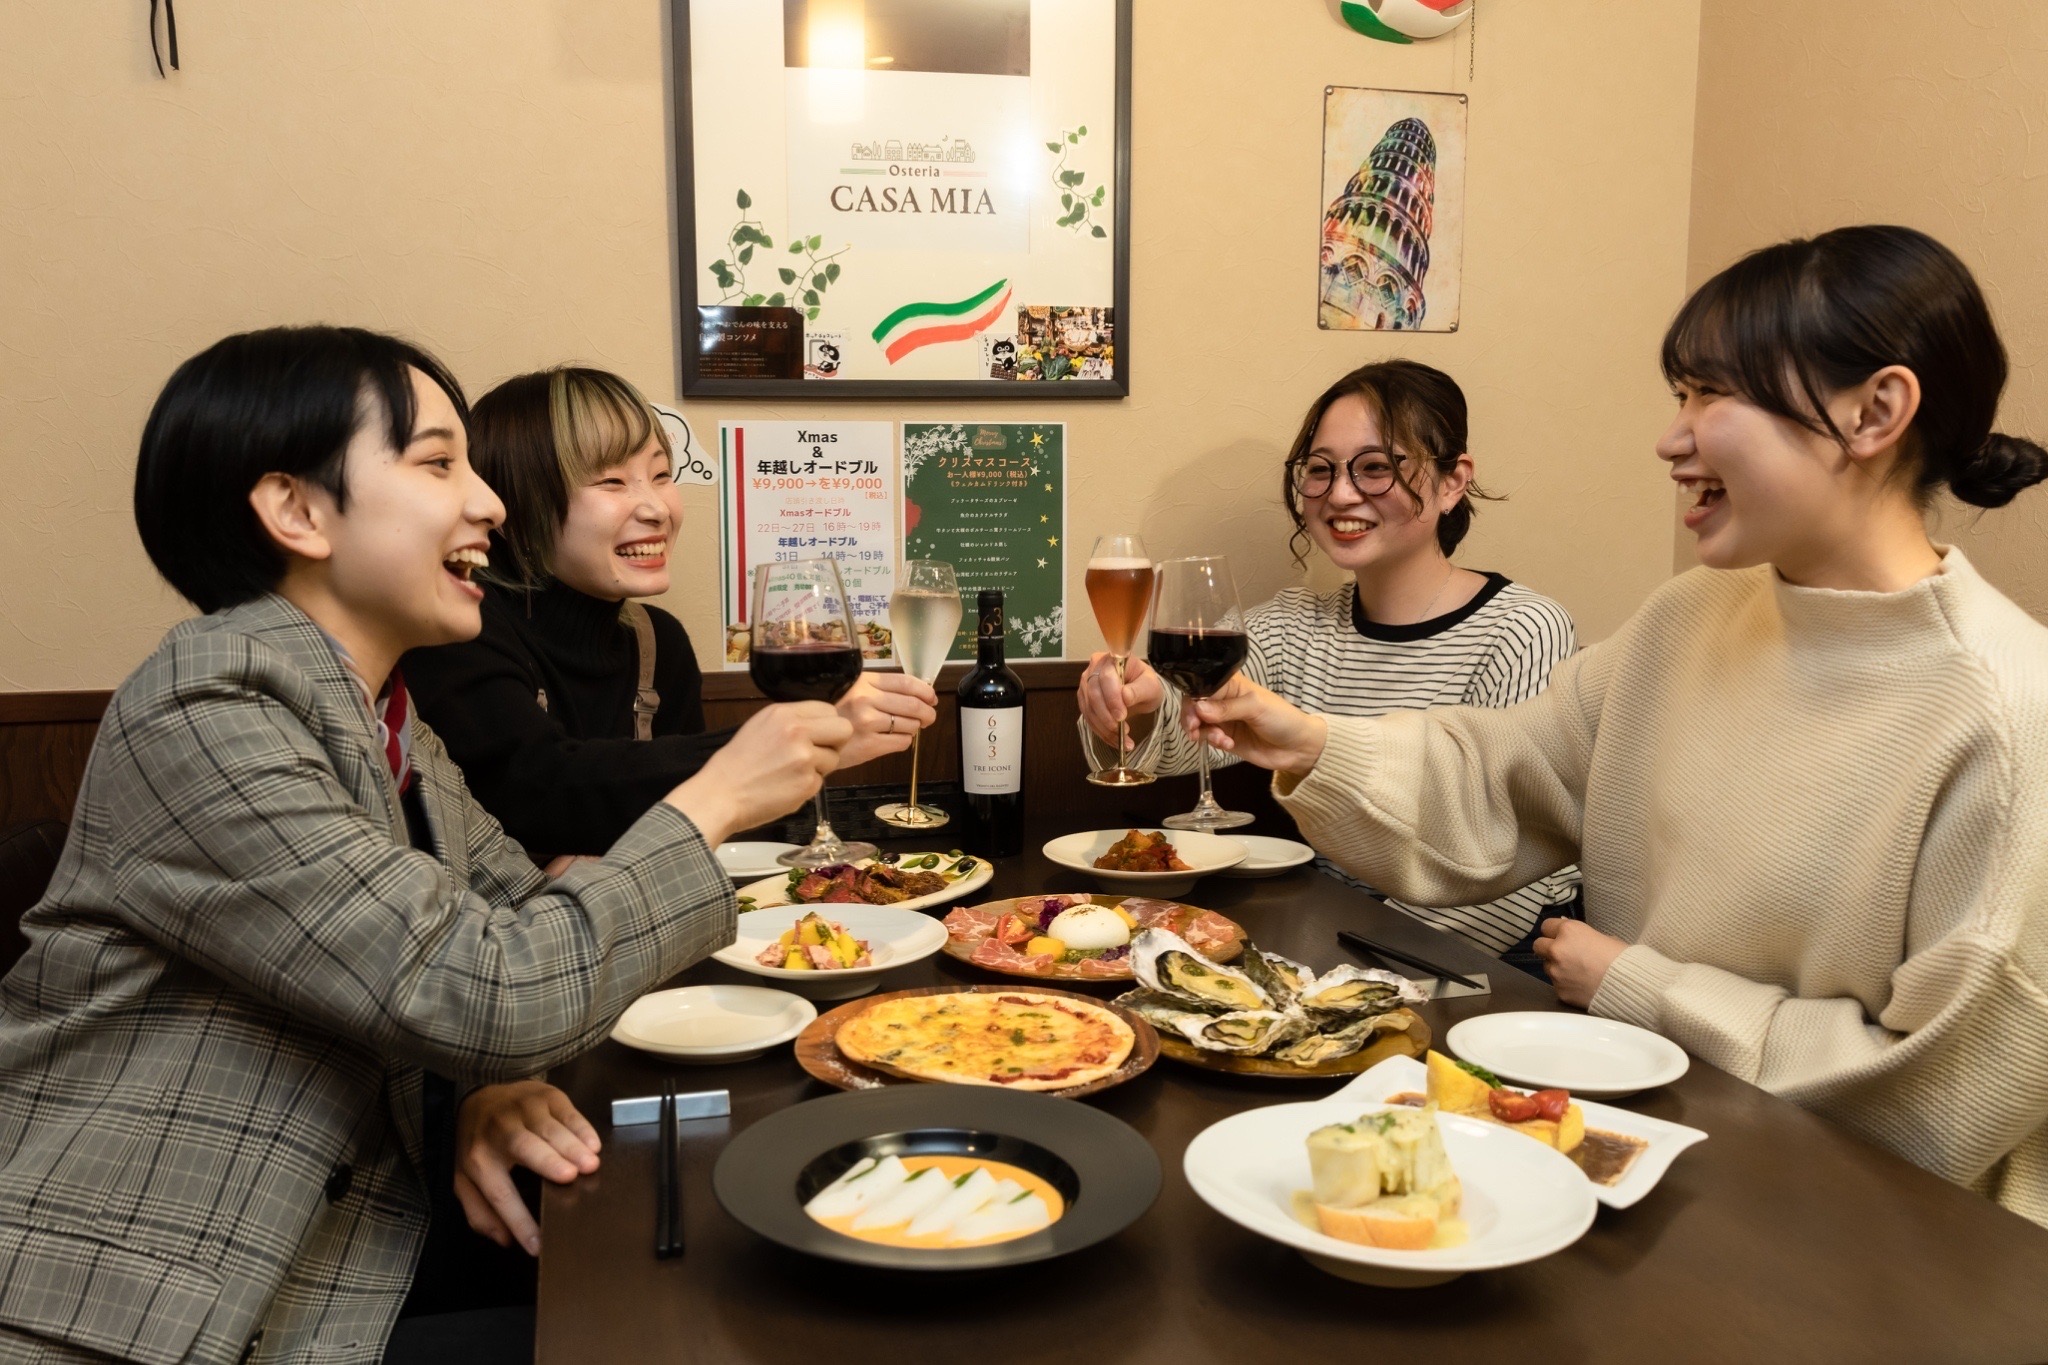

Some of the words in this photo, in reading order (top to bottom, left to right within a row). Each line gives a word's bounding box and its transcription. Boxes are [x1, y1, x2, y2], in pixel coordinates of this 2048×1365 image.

[889, 164, 940, 177] Osteria
[830, 185, 922, 213] CASA
[930, 187, 996, 214] MIA
[797, 430, 838, 443] Xmas
[812, 446, 824, 458] &
[757, 460, 878, 475] 年越しオードブル
[938, 457, 1030, 468] クリスマスコース
[780, 508, 851, 517] Xmasオードブル
[778, 537, 857, 547] 年越しオードブル
[775, 551, 798, 562] 31日
[988, 714, 996, 727] 6
[988, 730, 997, 743] 6
[988, 745, 997, 758] 3
